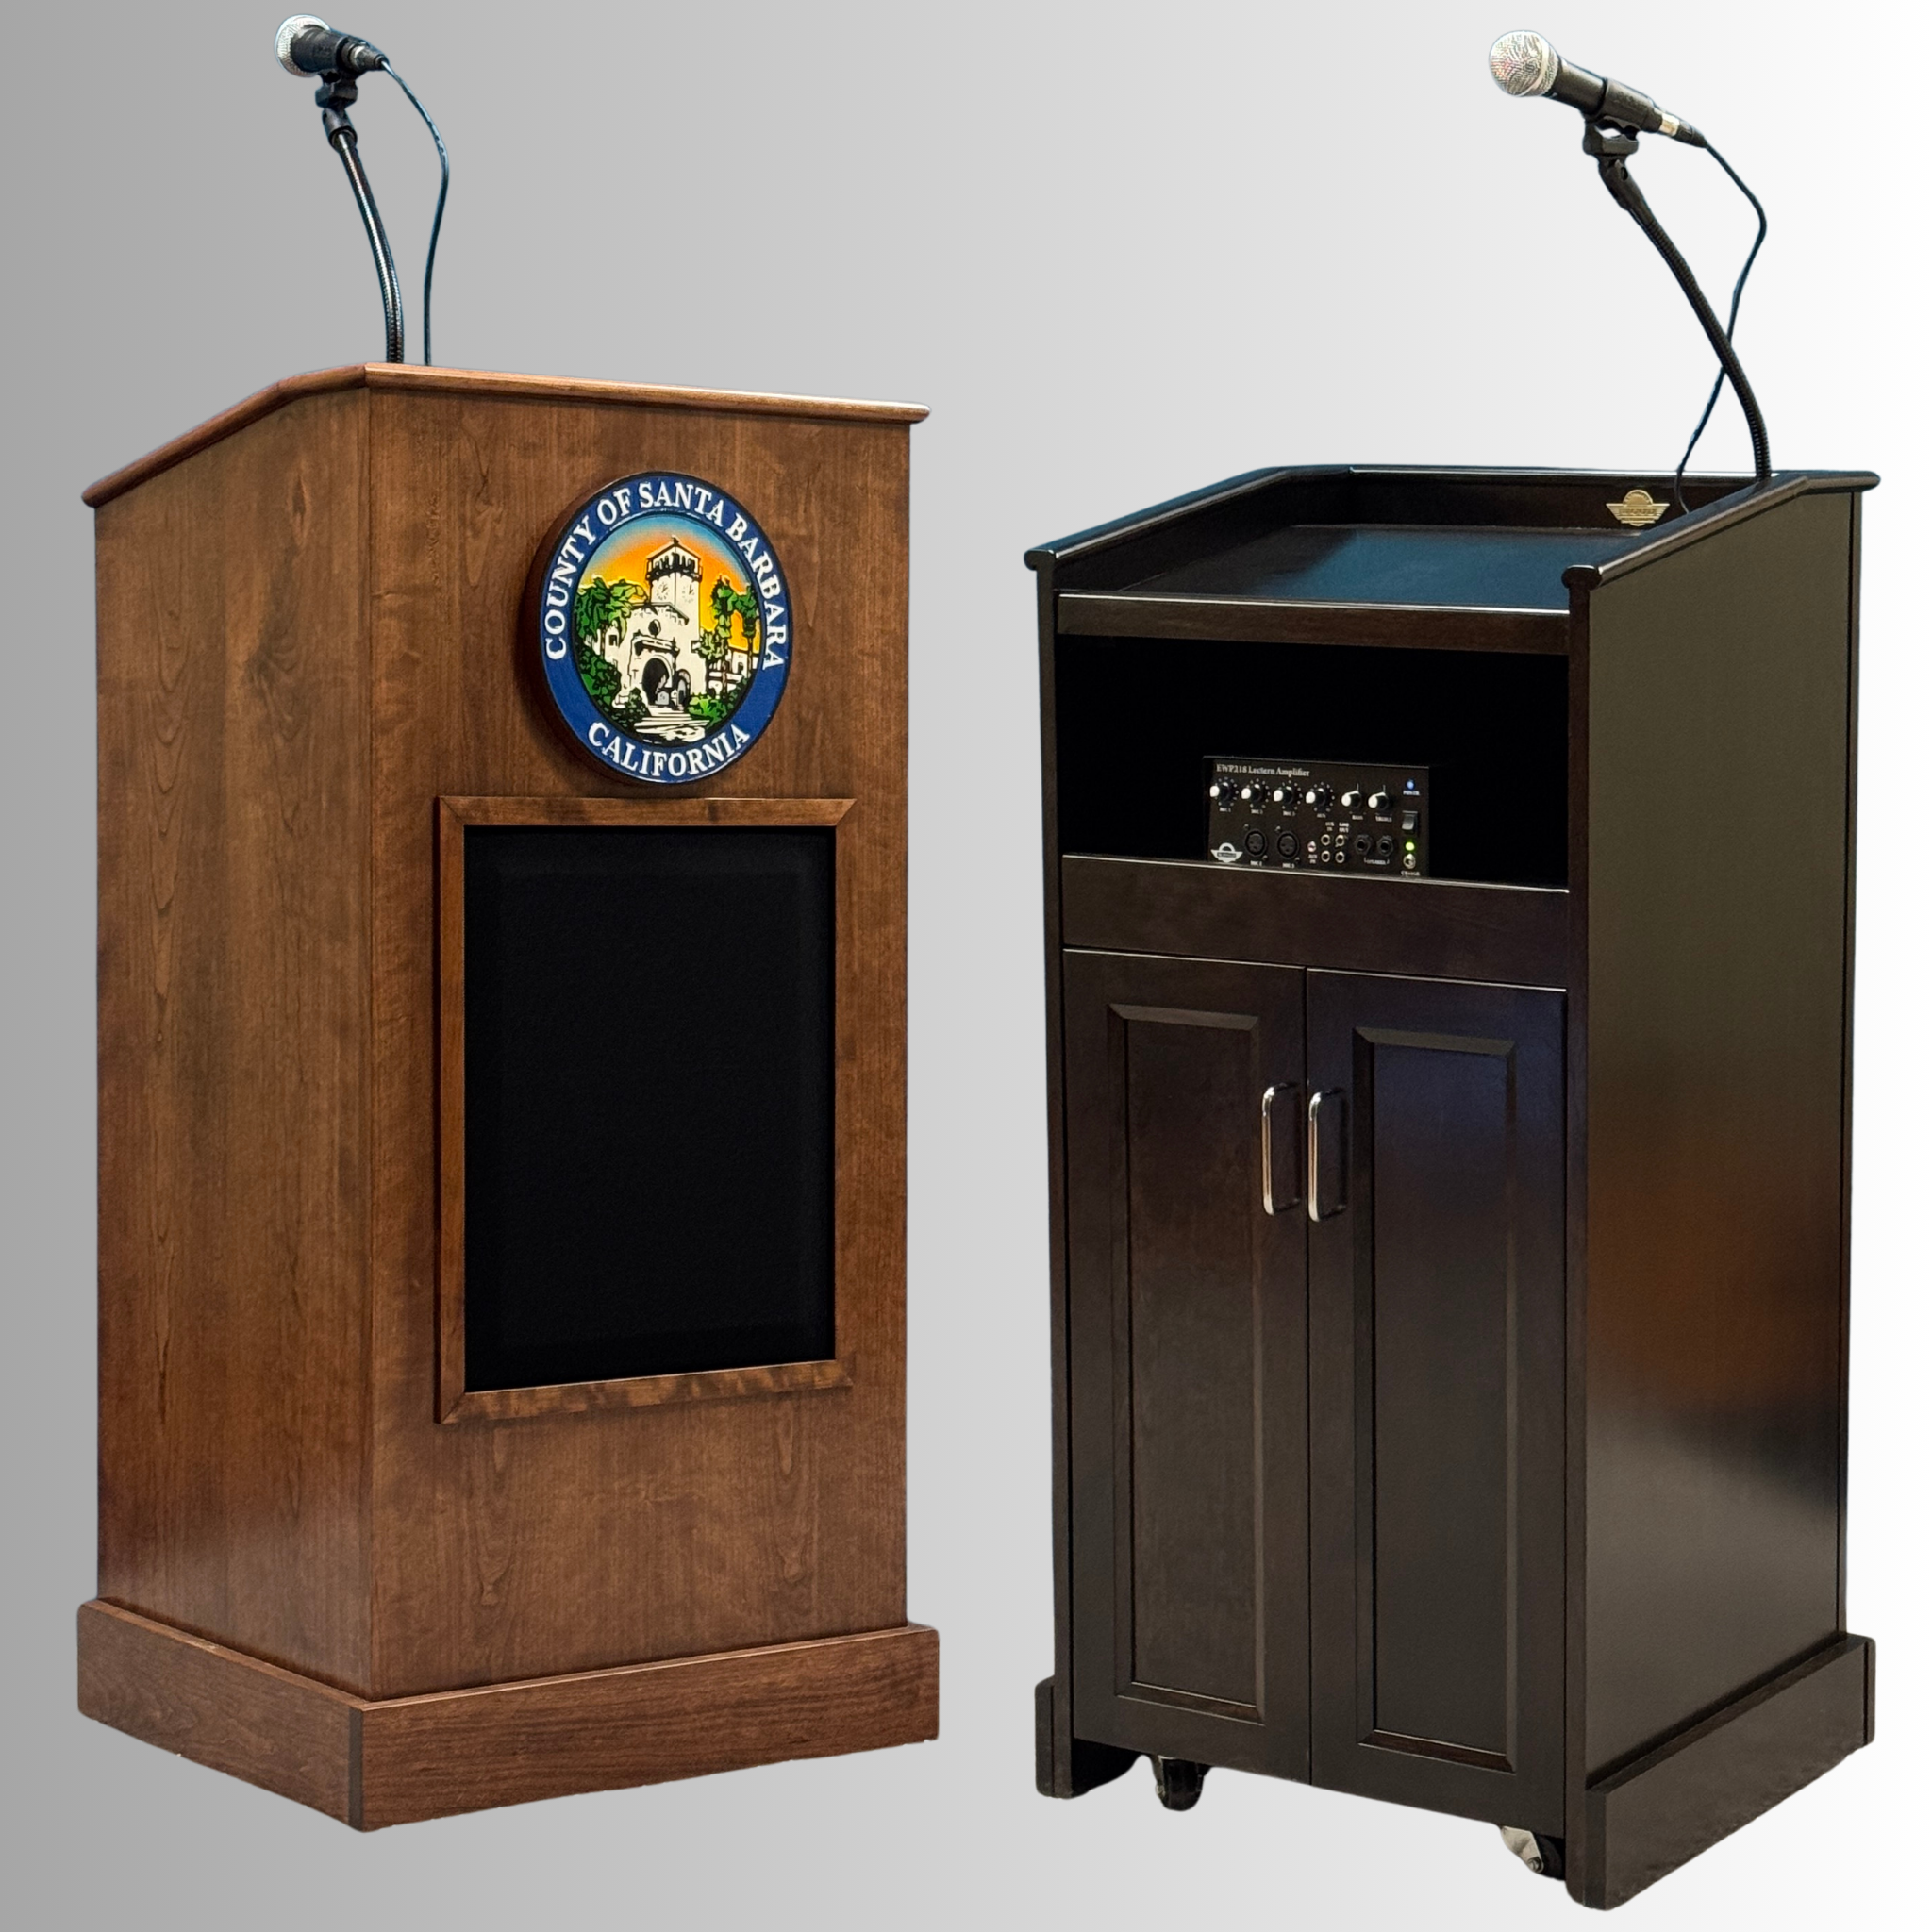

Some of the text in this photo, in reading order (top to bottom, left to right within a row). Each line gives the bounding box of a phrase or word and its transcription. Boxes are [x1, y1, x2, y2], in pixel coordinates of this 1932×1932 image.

[544, 482, 789, 671] COUNTY OF SANTA BARBARA
[588, 721, 751, 777] CALIFORNIA
[1248, 765, 1275, 775] Lectern
[1276, 766, 1310, 778] Amplifier
